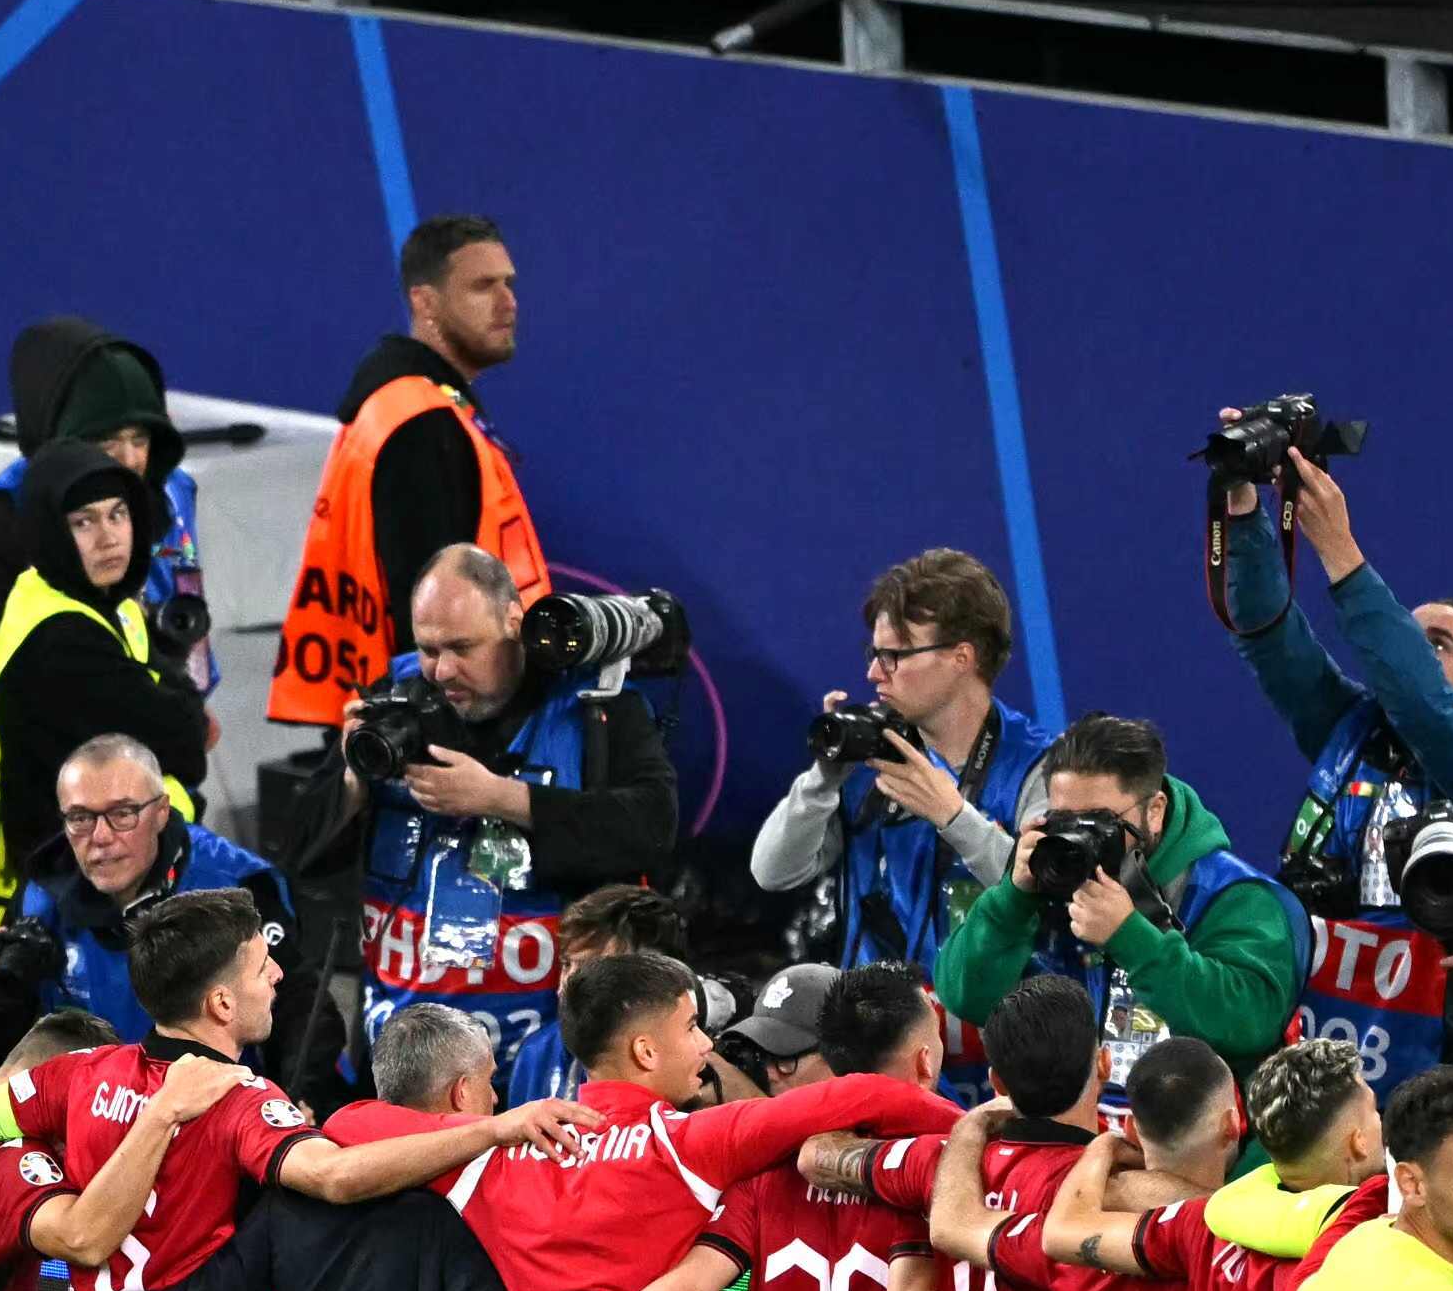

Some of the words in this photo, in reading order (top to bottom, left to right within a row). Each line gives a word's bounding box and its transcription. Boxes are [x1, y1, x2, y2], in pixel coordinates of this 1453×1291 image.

[1283, 501, 1293, 531] EOS
[1211, 520, 1222, 566] Canon
[975, 730, 995, 770] SONY
